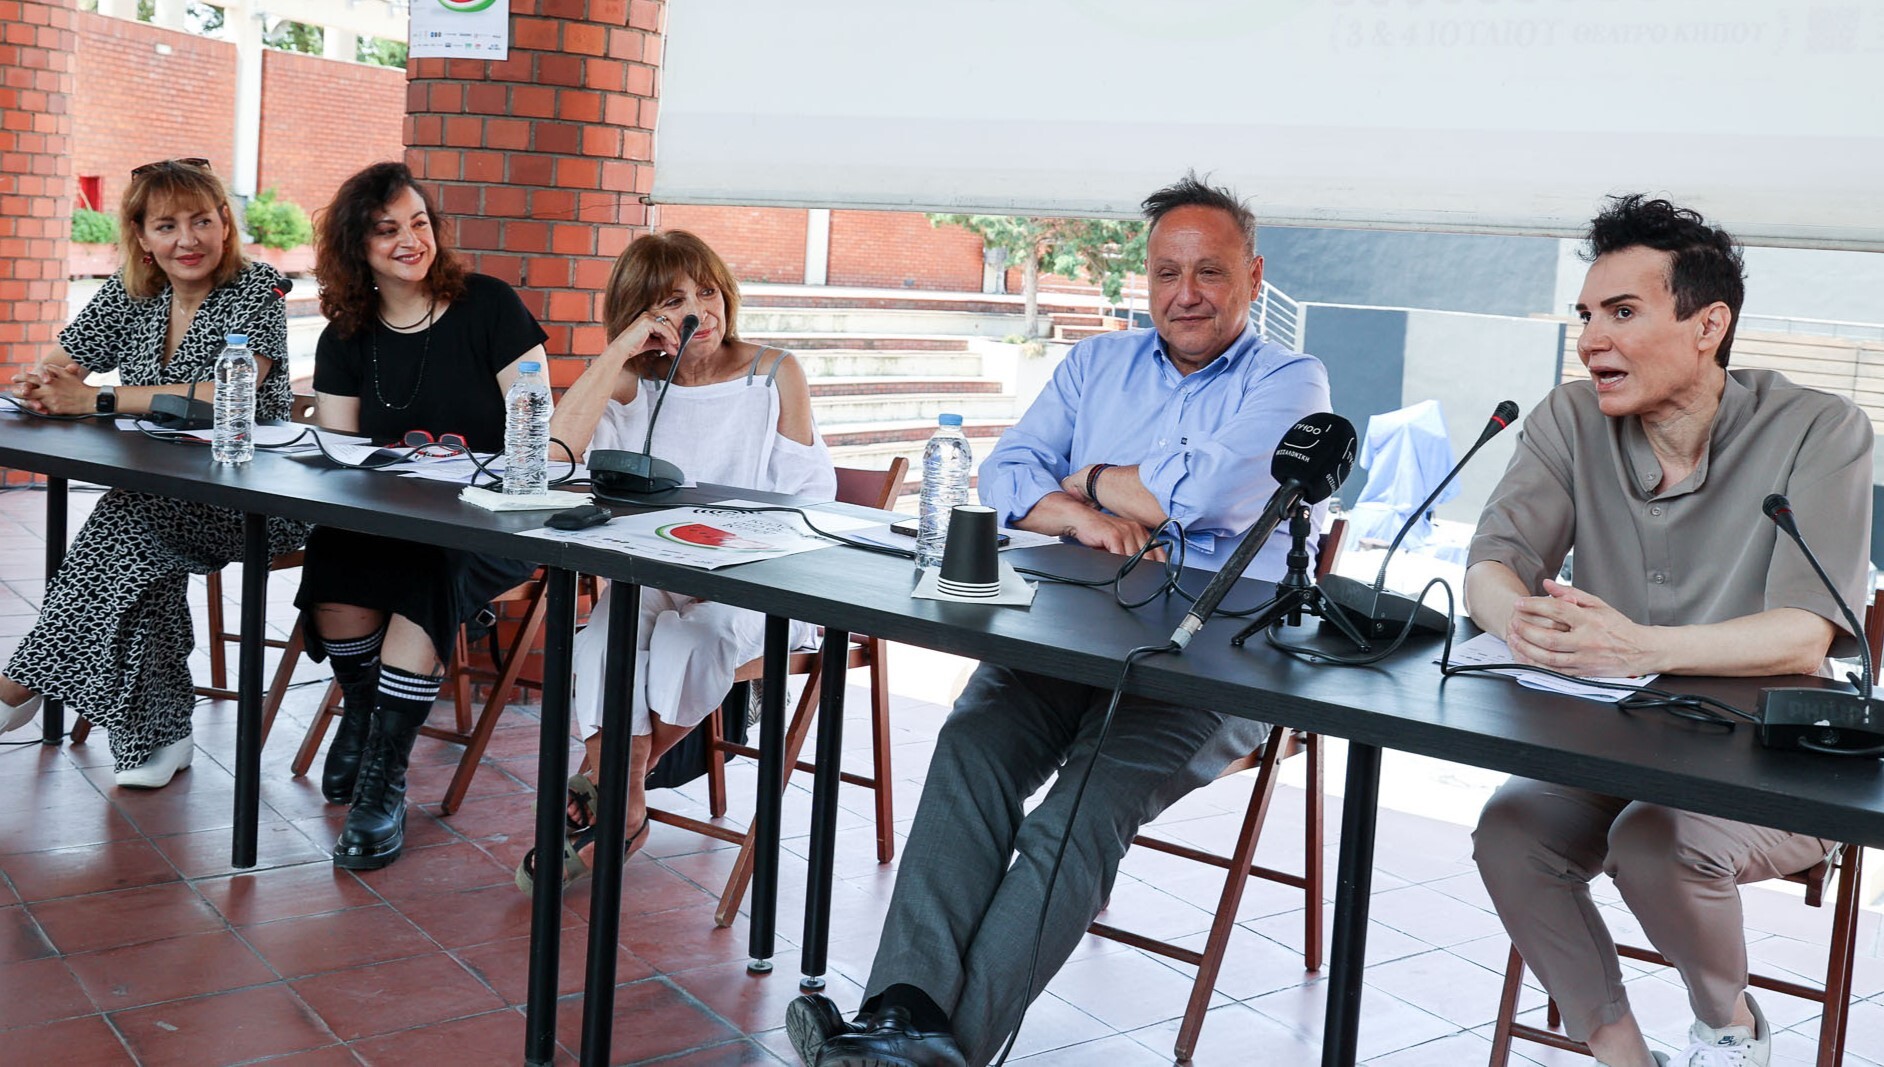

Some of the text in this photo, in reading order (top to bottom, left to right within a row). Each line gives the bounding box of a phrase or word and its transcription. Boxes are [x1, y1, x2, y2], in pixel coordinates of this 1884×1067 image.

[1371, 19, 1394, 47] &
[1400, 19, 1421, 48] 4
[1426, 17, 1564, 48] ΙΟΥΛΙΟΥ
[1571, 21, 1668, 45] ΘΕΑΤΡΟ
[1672, 20, 1768, 45] ΚΗΠΟΥ
